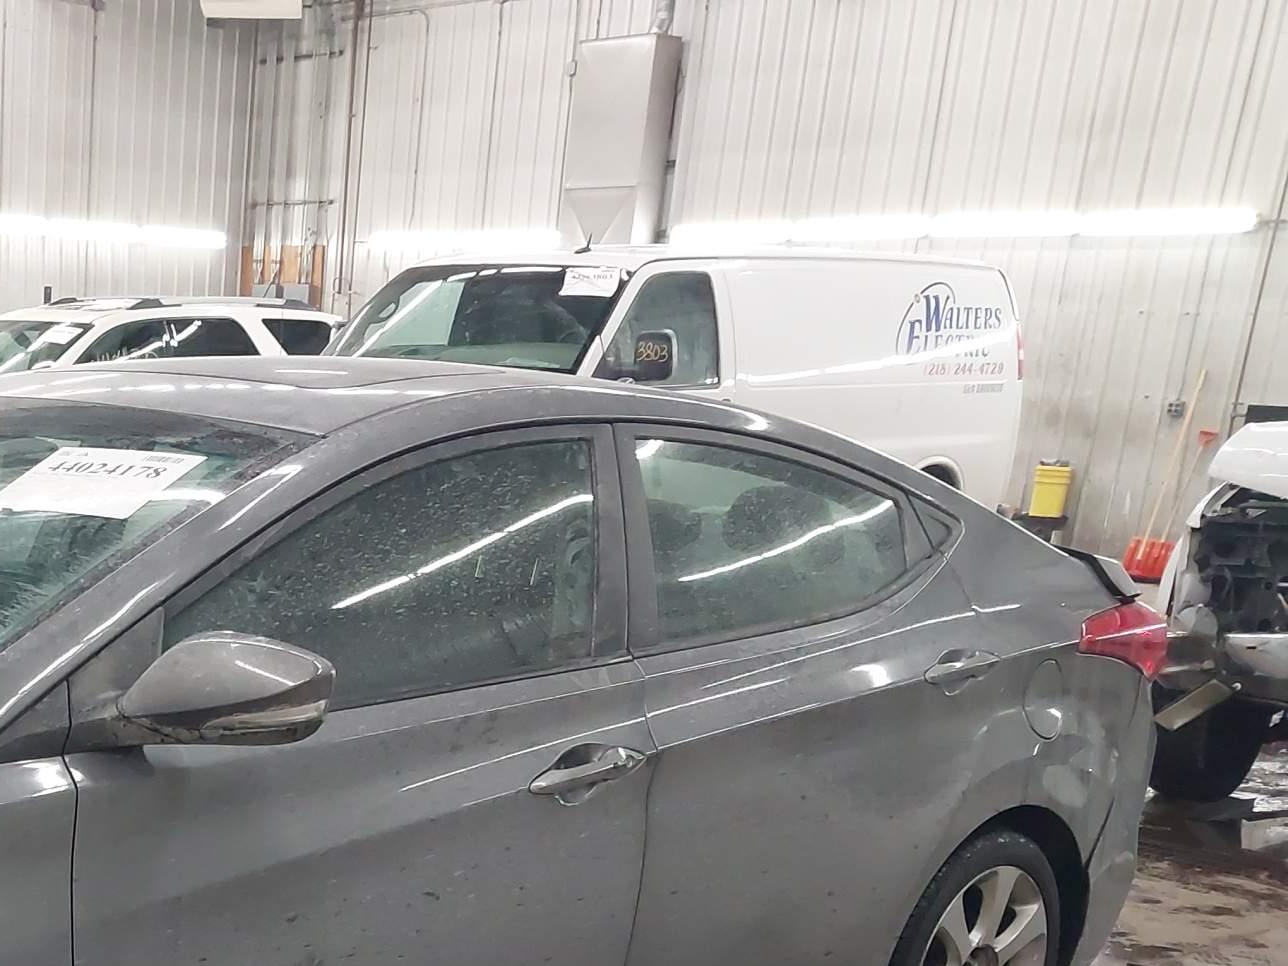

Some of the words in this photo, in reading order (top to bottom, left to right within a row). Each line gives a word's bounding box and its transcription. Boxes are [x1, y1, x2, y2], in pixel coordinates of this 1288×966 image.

[922, 294, 1002, 333] WALTERS
[636, 341, 669, 362] 3803
[48, 460, 168, 479] 44024178
